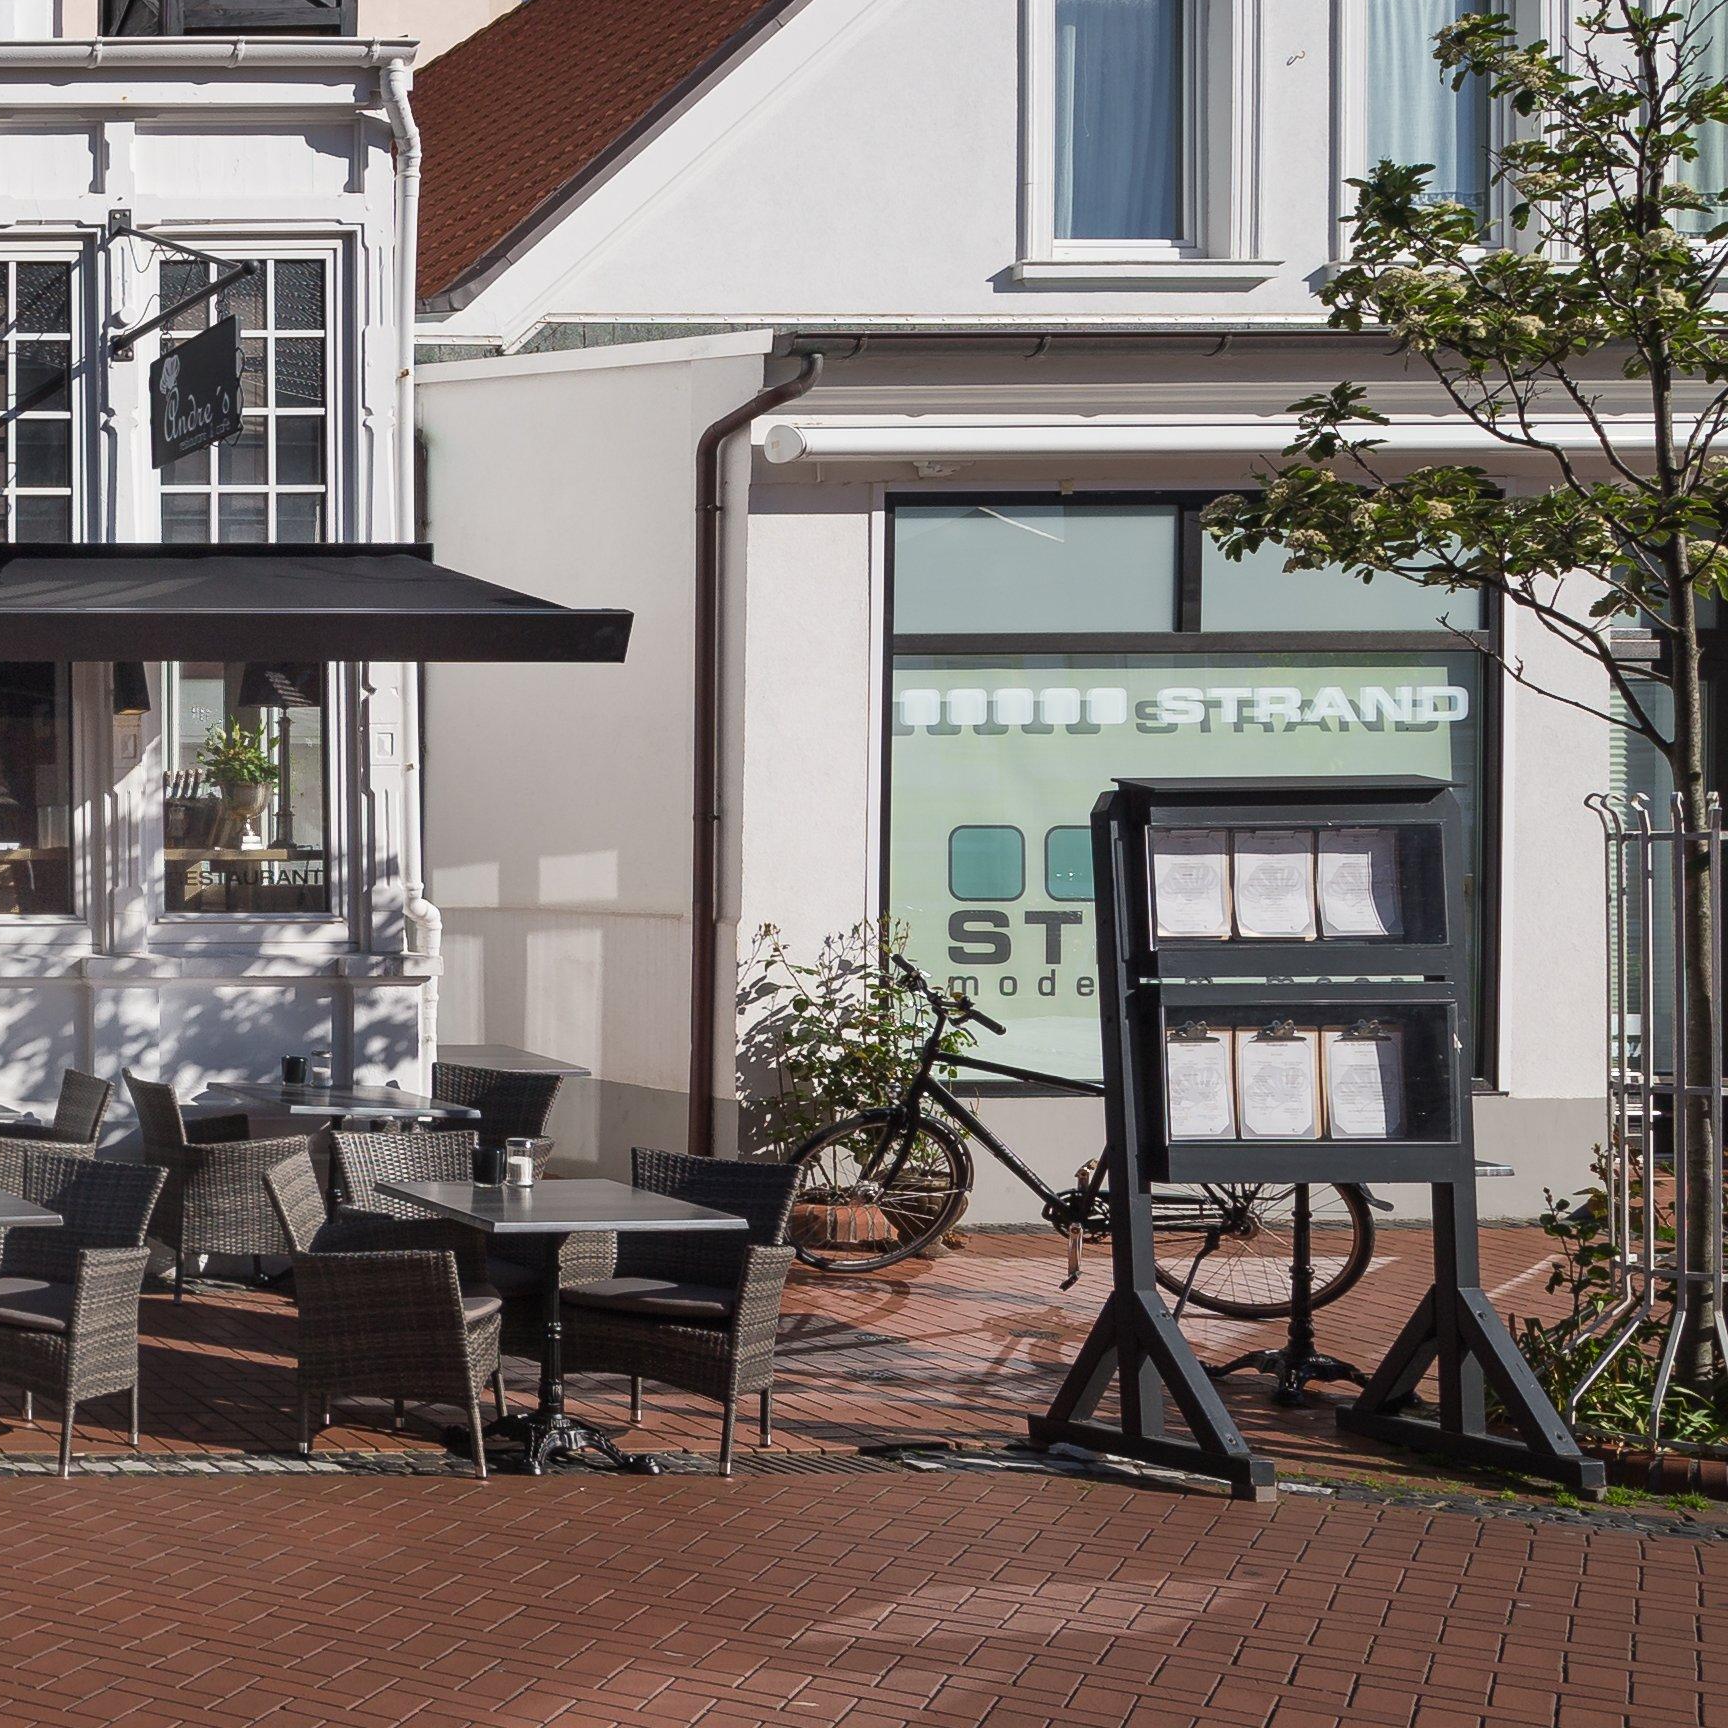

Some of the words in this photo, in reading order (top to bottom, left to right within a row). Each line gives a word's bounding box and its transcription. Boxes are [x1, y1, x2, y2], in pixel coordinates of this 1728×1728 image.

[1155, 684, 1470, 726] STRAND
[177, 869, 324, 887] ESTAURANT
[947, 909, 1085, 966] ST
